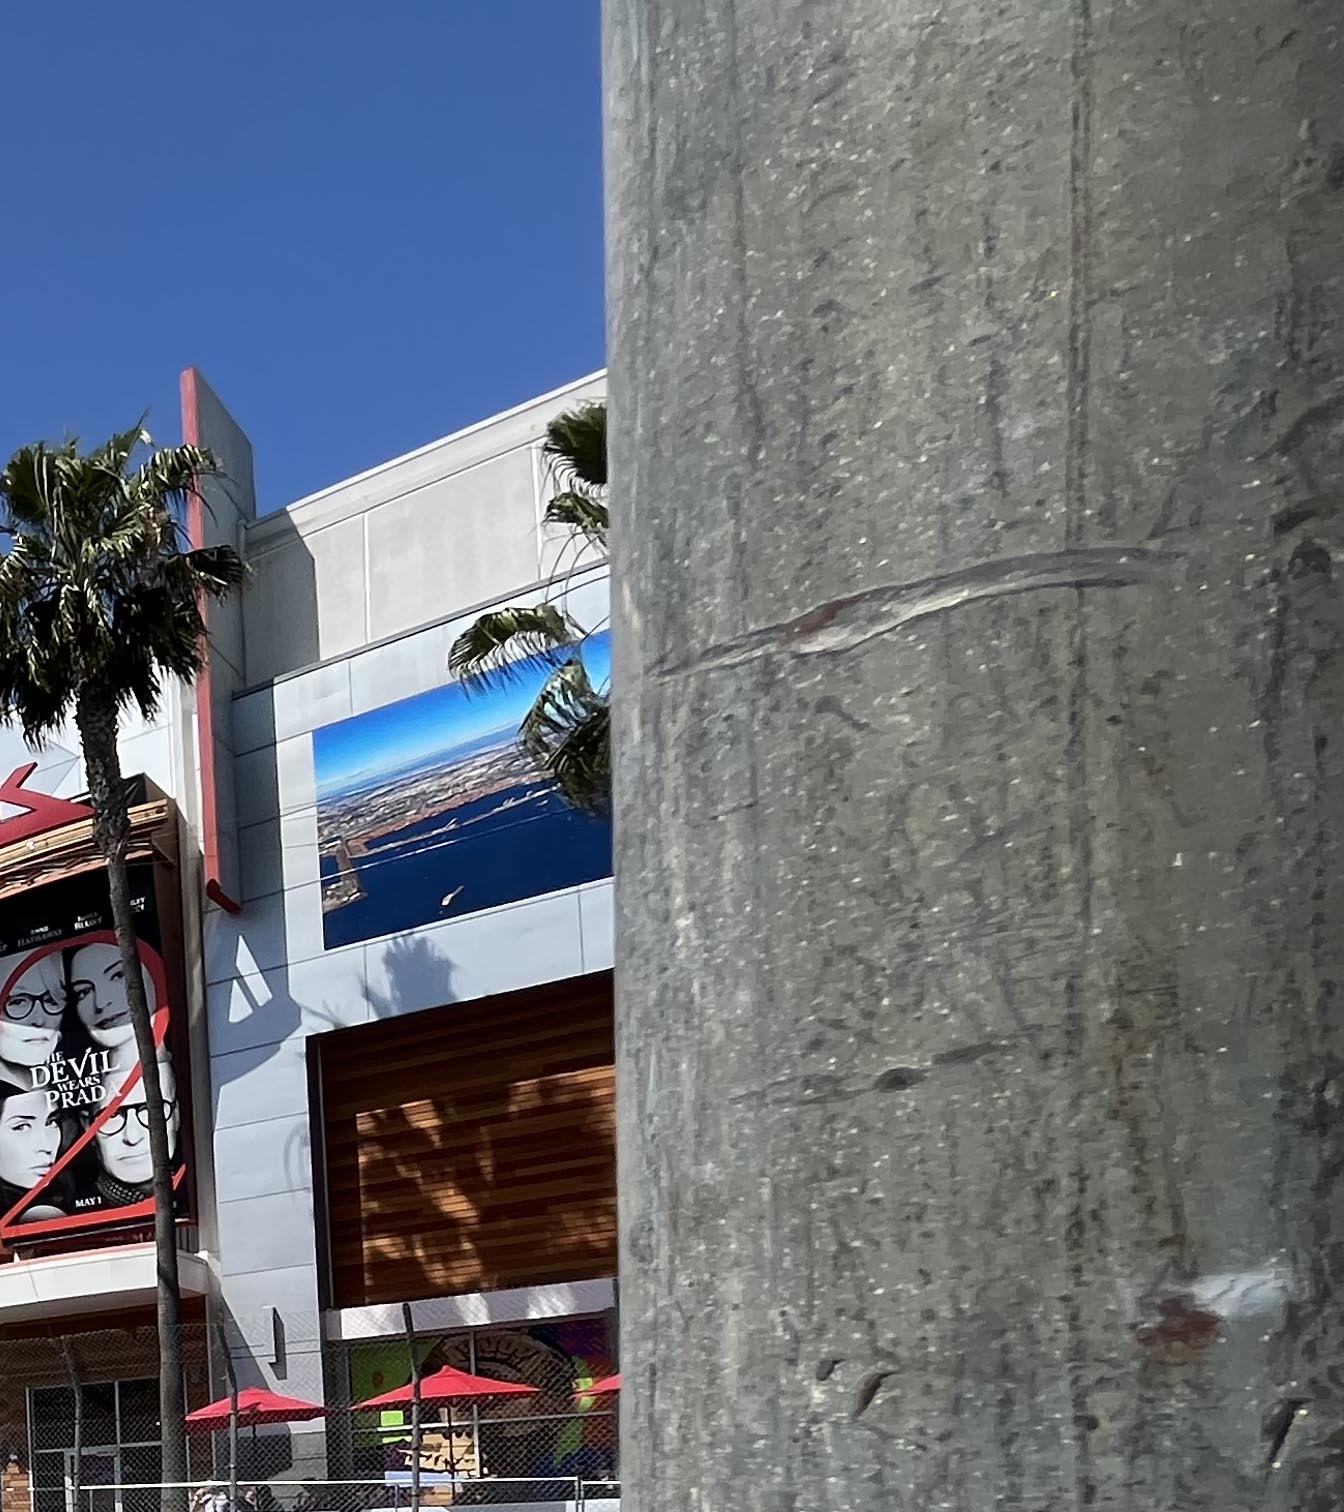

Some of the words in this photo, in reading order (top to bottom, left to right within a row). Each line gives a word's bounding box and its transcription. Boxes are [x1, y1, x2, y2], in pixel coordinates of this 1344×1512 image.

[30, 1047, 120, 1089] DEVIL
[57, 1075, 101, 1092] WEARS
[75, 1198, 96, 1208] MAY
